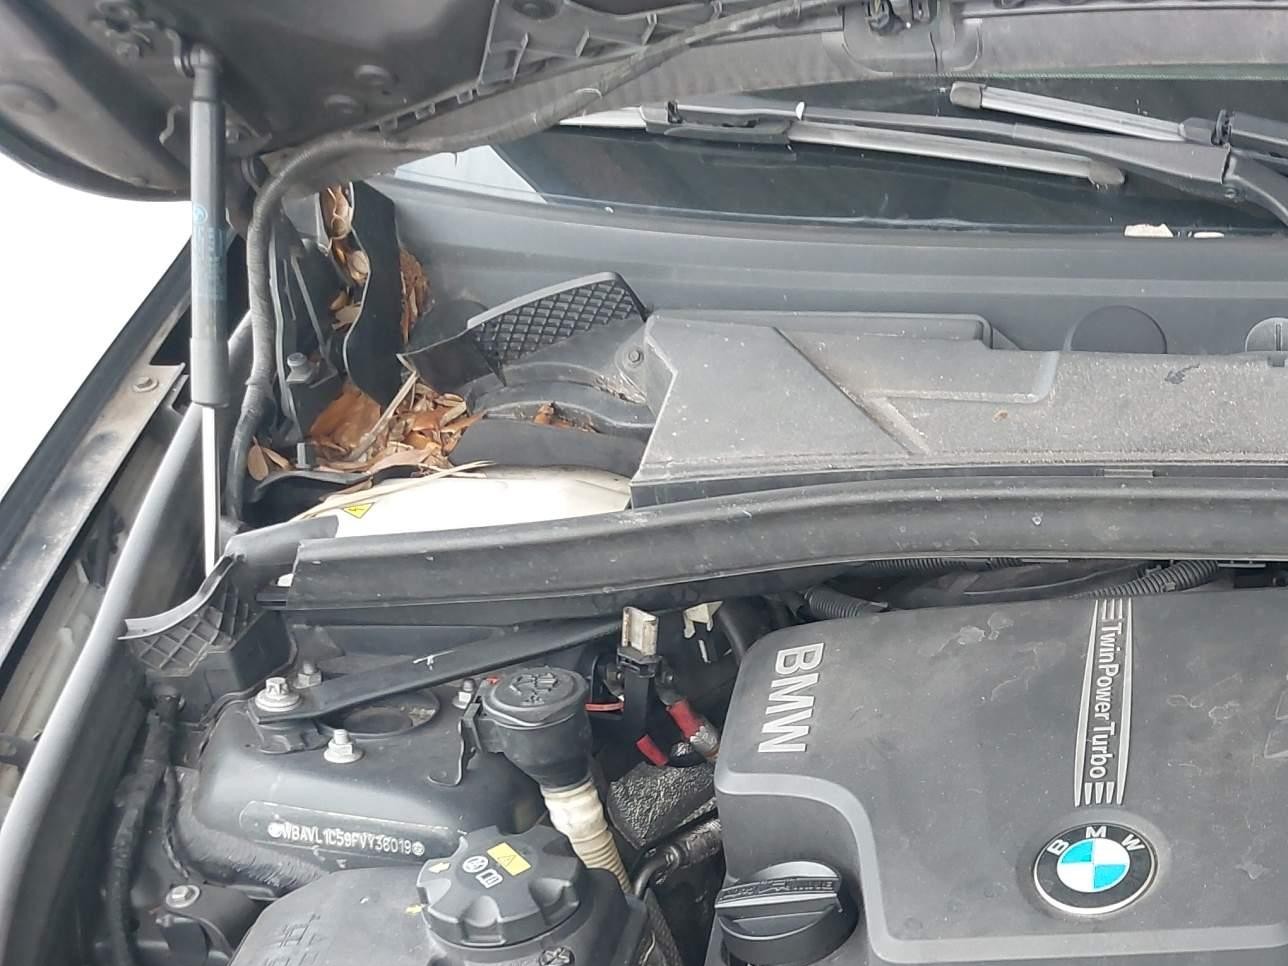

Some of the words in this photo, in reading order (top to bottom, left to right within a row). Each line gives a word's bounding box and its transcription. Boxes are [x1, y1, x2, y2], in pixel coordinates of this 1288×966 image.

[758, 642, 825, 753] BMW
[1094, 621, 1123, 720] TwinPower
[1089, 721, 1117, 779] Turbo
[1046, 825, 1146, 856] BMW
